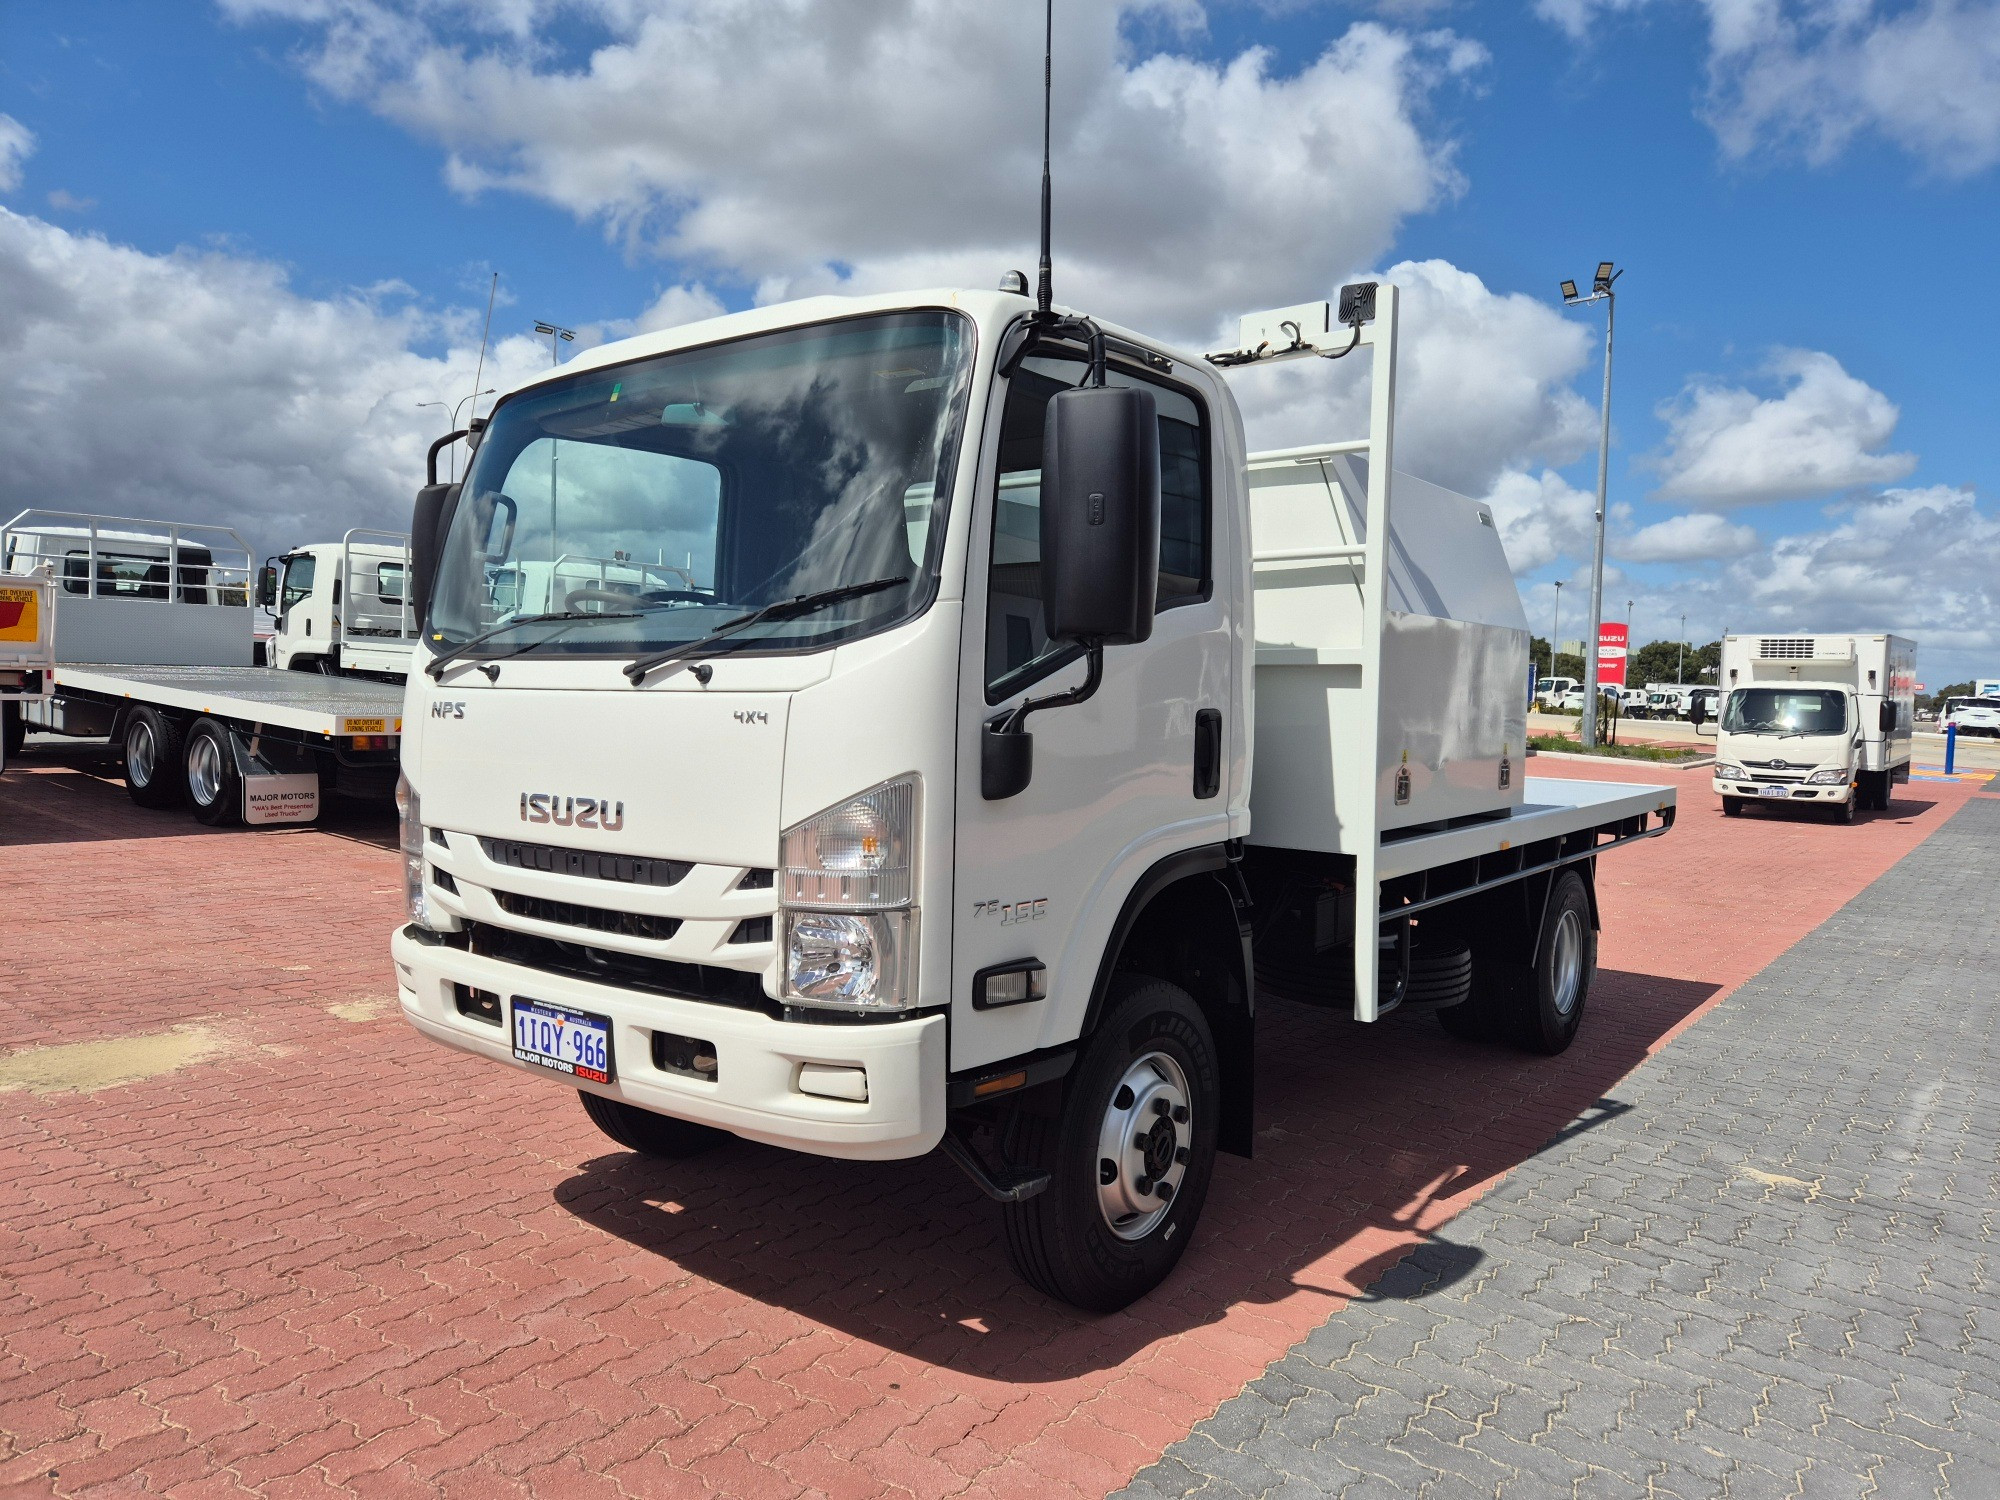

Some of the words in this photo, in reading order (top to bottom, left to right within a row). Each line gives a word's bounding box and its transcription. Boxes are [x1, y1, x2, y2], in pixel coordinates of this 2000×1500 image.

[431, 701, 466, 720] NPS
[733, 710, 769, 725] 4X4
[249, 793, 279, 802] MAJOR
[280, 792, 315, 801] MOTORS
[520, 792, 624, 832] ISUZU
[530, 1007, 552, 1017] WESTERN
[569, 1016, 592, 1027] AUSTRALIA
[514, 1048, 541, 1063] MAJOR
[541, 1054, 574, 1074] MOTORS
[575, 1065, 608, 1083] ISUZU
